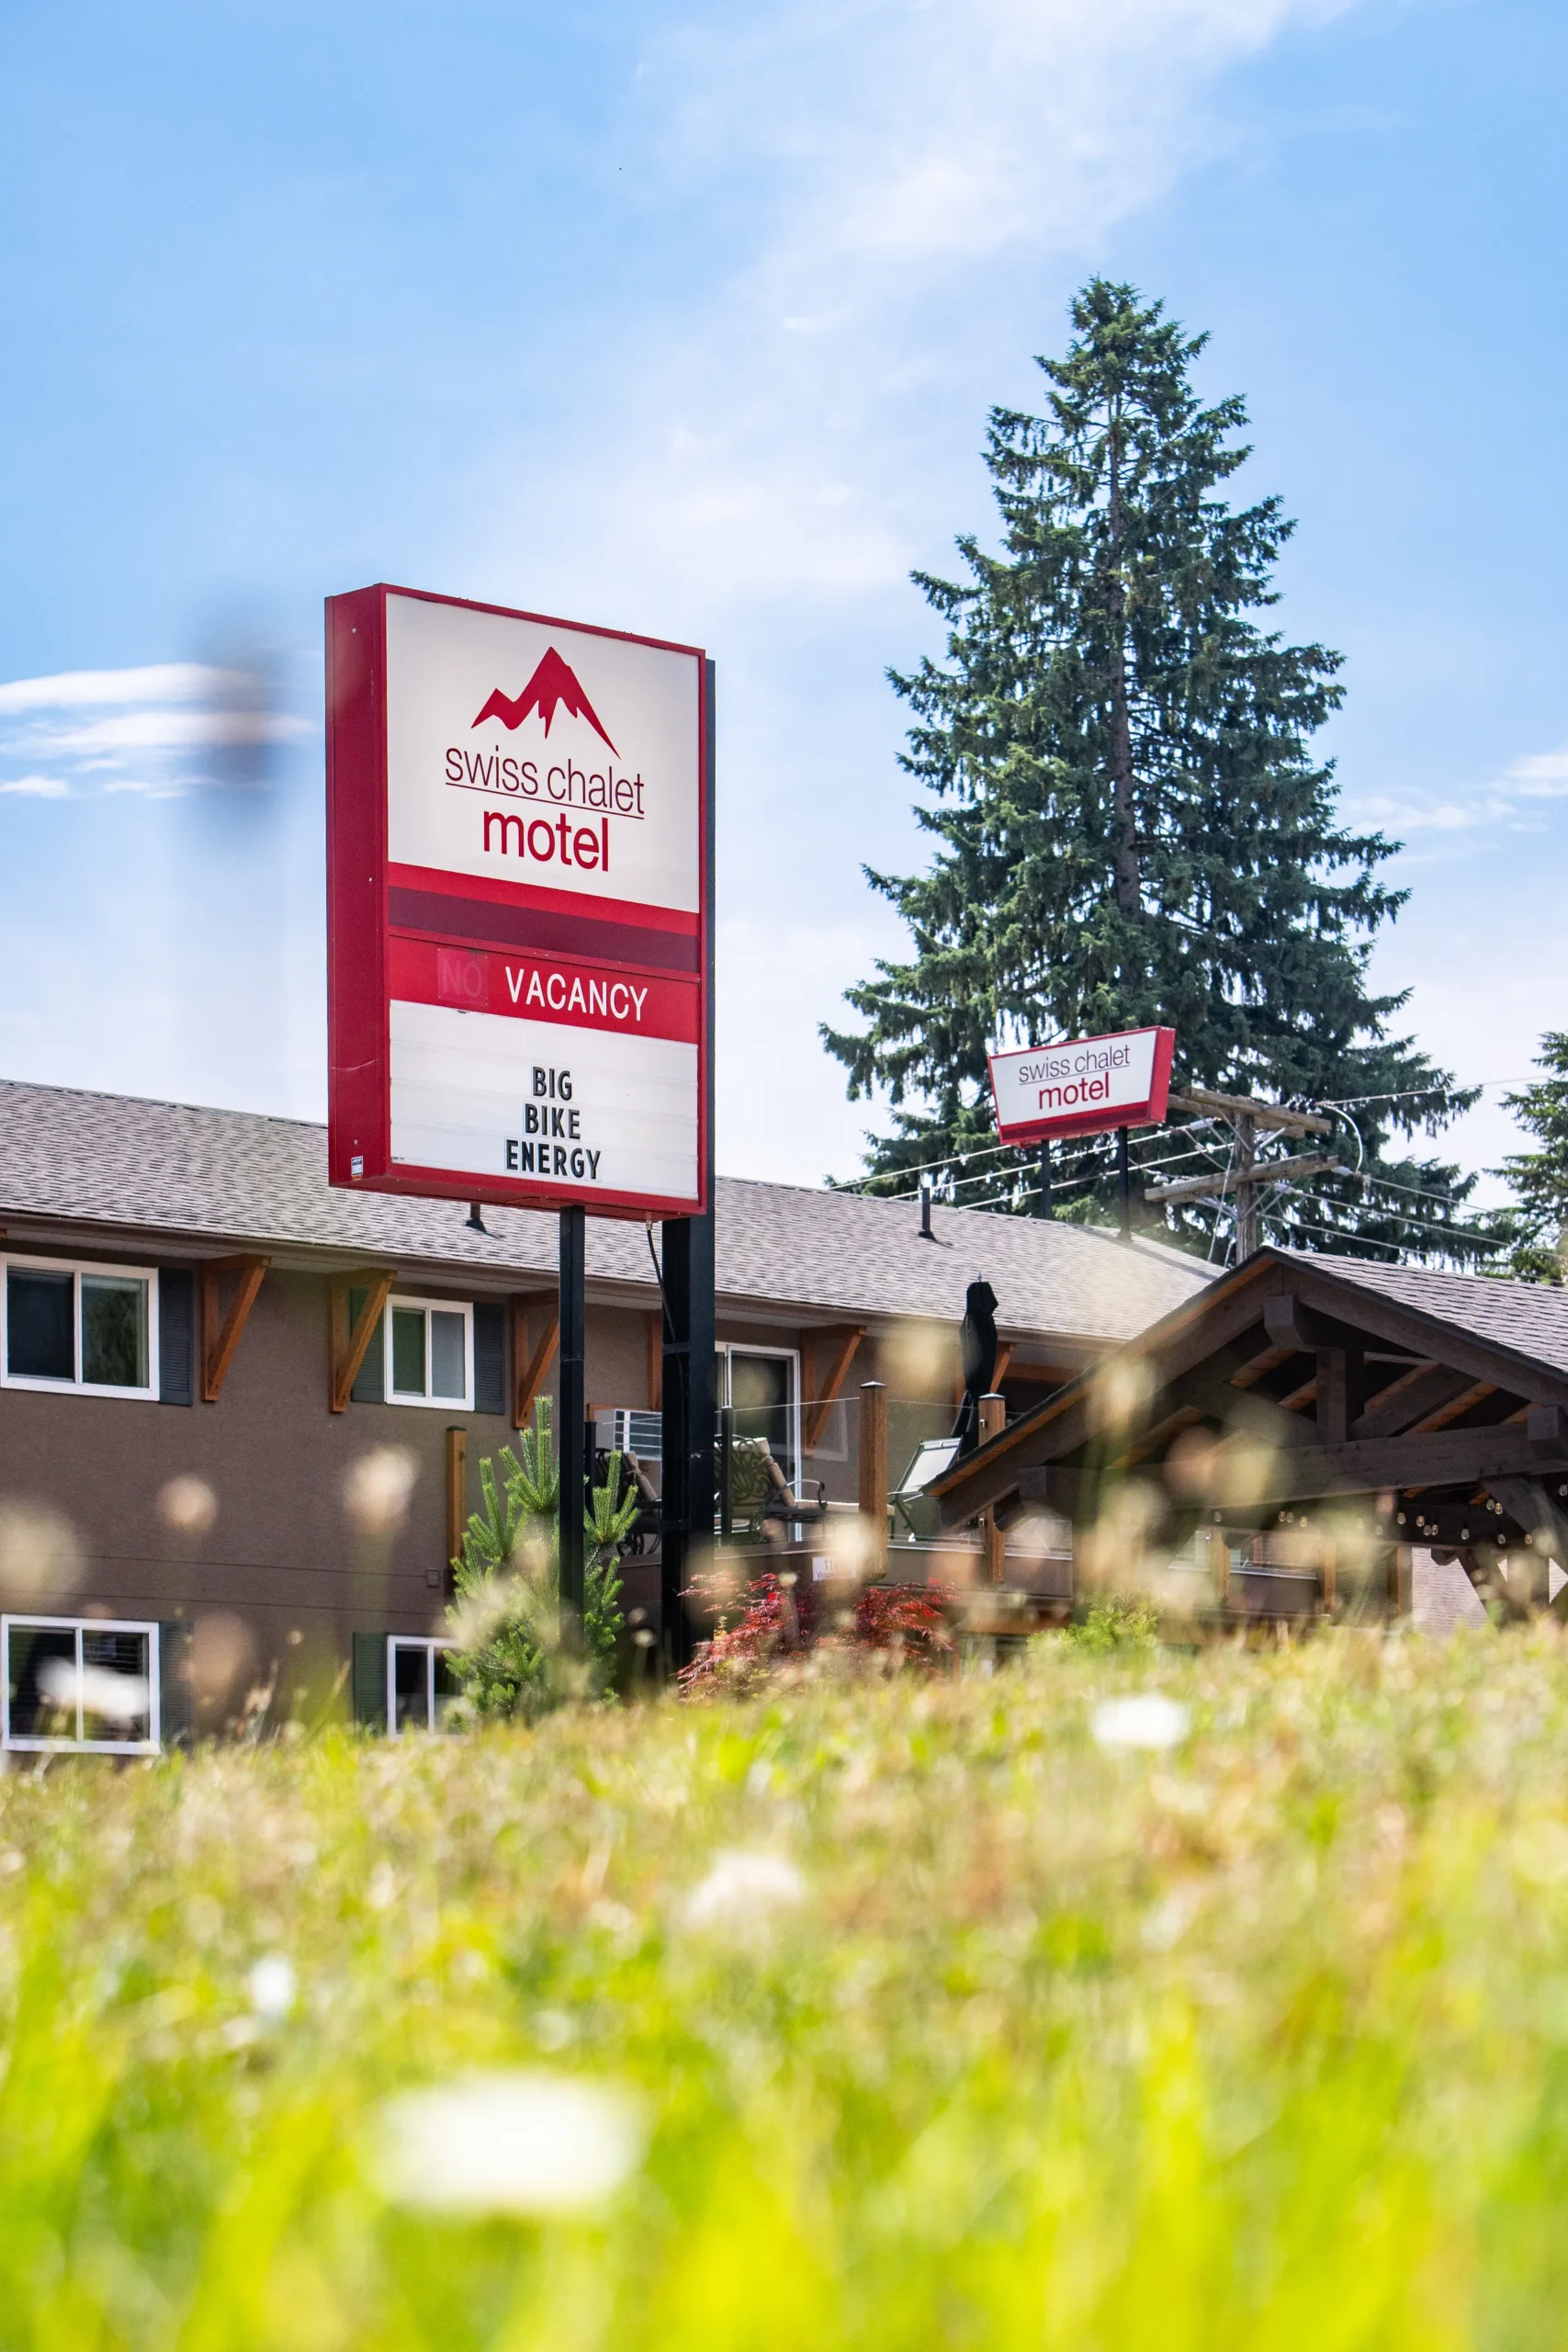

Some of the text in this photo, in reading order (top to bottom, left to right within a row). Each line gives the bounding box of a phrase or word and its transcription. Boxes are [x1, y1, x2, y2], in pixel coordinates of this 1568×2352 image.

[446, 744, 645, 815] swiss chalet
[483, 810, 609, 872] motel
[442, 956, 649, 1022] NO VACANCY
[1019, 1044, 1130, 1083] swiss chalet
[532, 1067, 572, 1101] BIG
[1039, 1071, 1110, 1110] motel
[525, 1103, 581, 1140] BIKE
[505, 1139, 602, 1180] ENERGY
